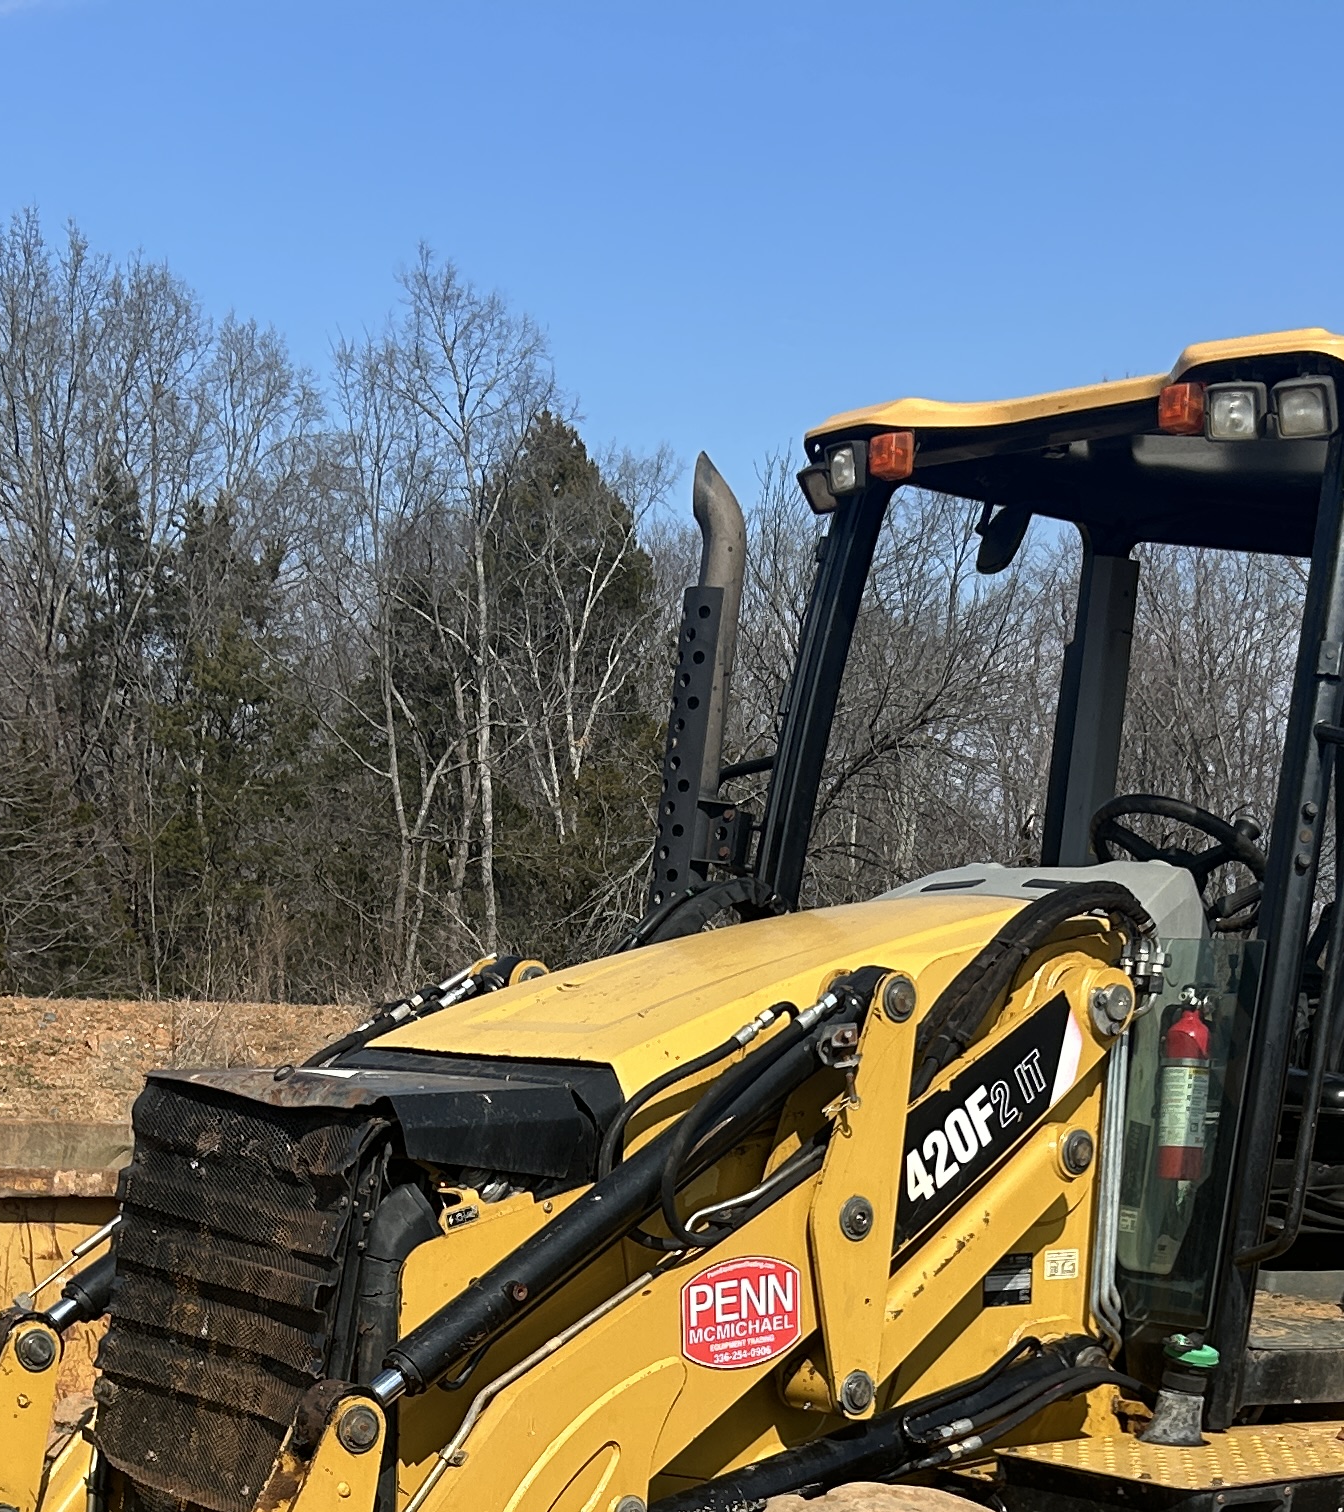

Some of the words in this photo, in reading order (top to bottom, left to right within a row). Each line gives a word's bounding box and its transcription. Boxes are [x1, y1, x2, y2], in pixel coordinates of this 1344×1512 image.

[1013, 1048, 1048, 1105] IT
[688, 1271, 794, 1327] PENN
[688, 1314, 795, 1345] MCMICHAEL
[709, 1338, 747, 1352] EQUIPMENT
[747, 1333, 775, 1346] TRADING
